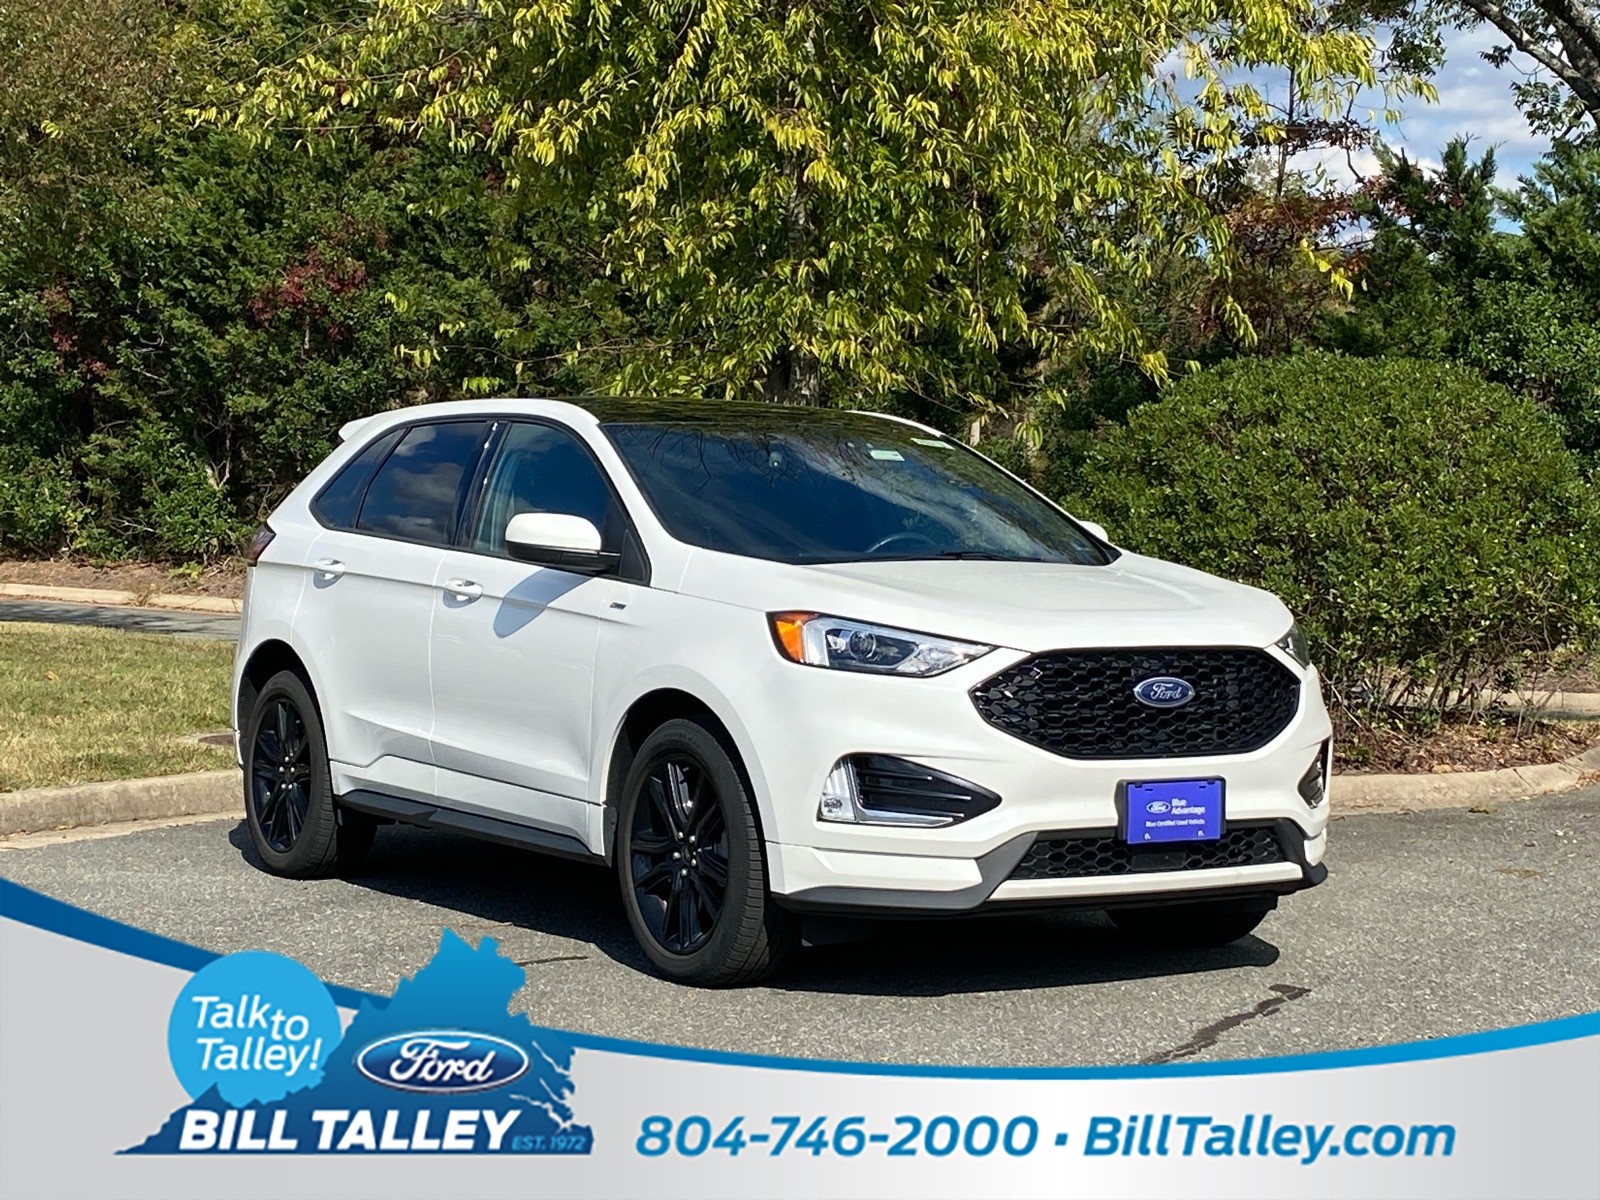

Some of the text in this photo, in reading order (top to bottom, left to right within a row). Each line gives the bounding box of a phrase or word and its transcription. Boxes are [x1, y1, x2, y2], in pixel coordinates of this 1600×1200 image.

[1150, 682, 1182, 700] Ford
[1171, 798, 1187, 807] Blue
[1171, 806, 1206, 815] Advantage
[1156, 819, 1176, 827] Certified
